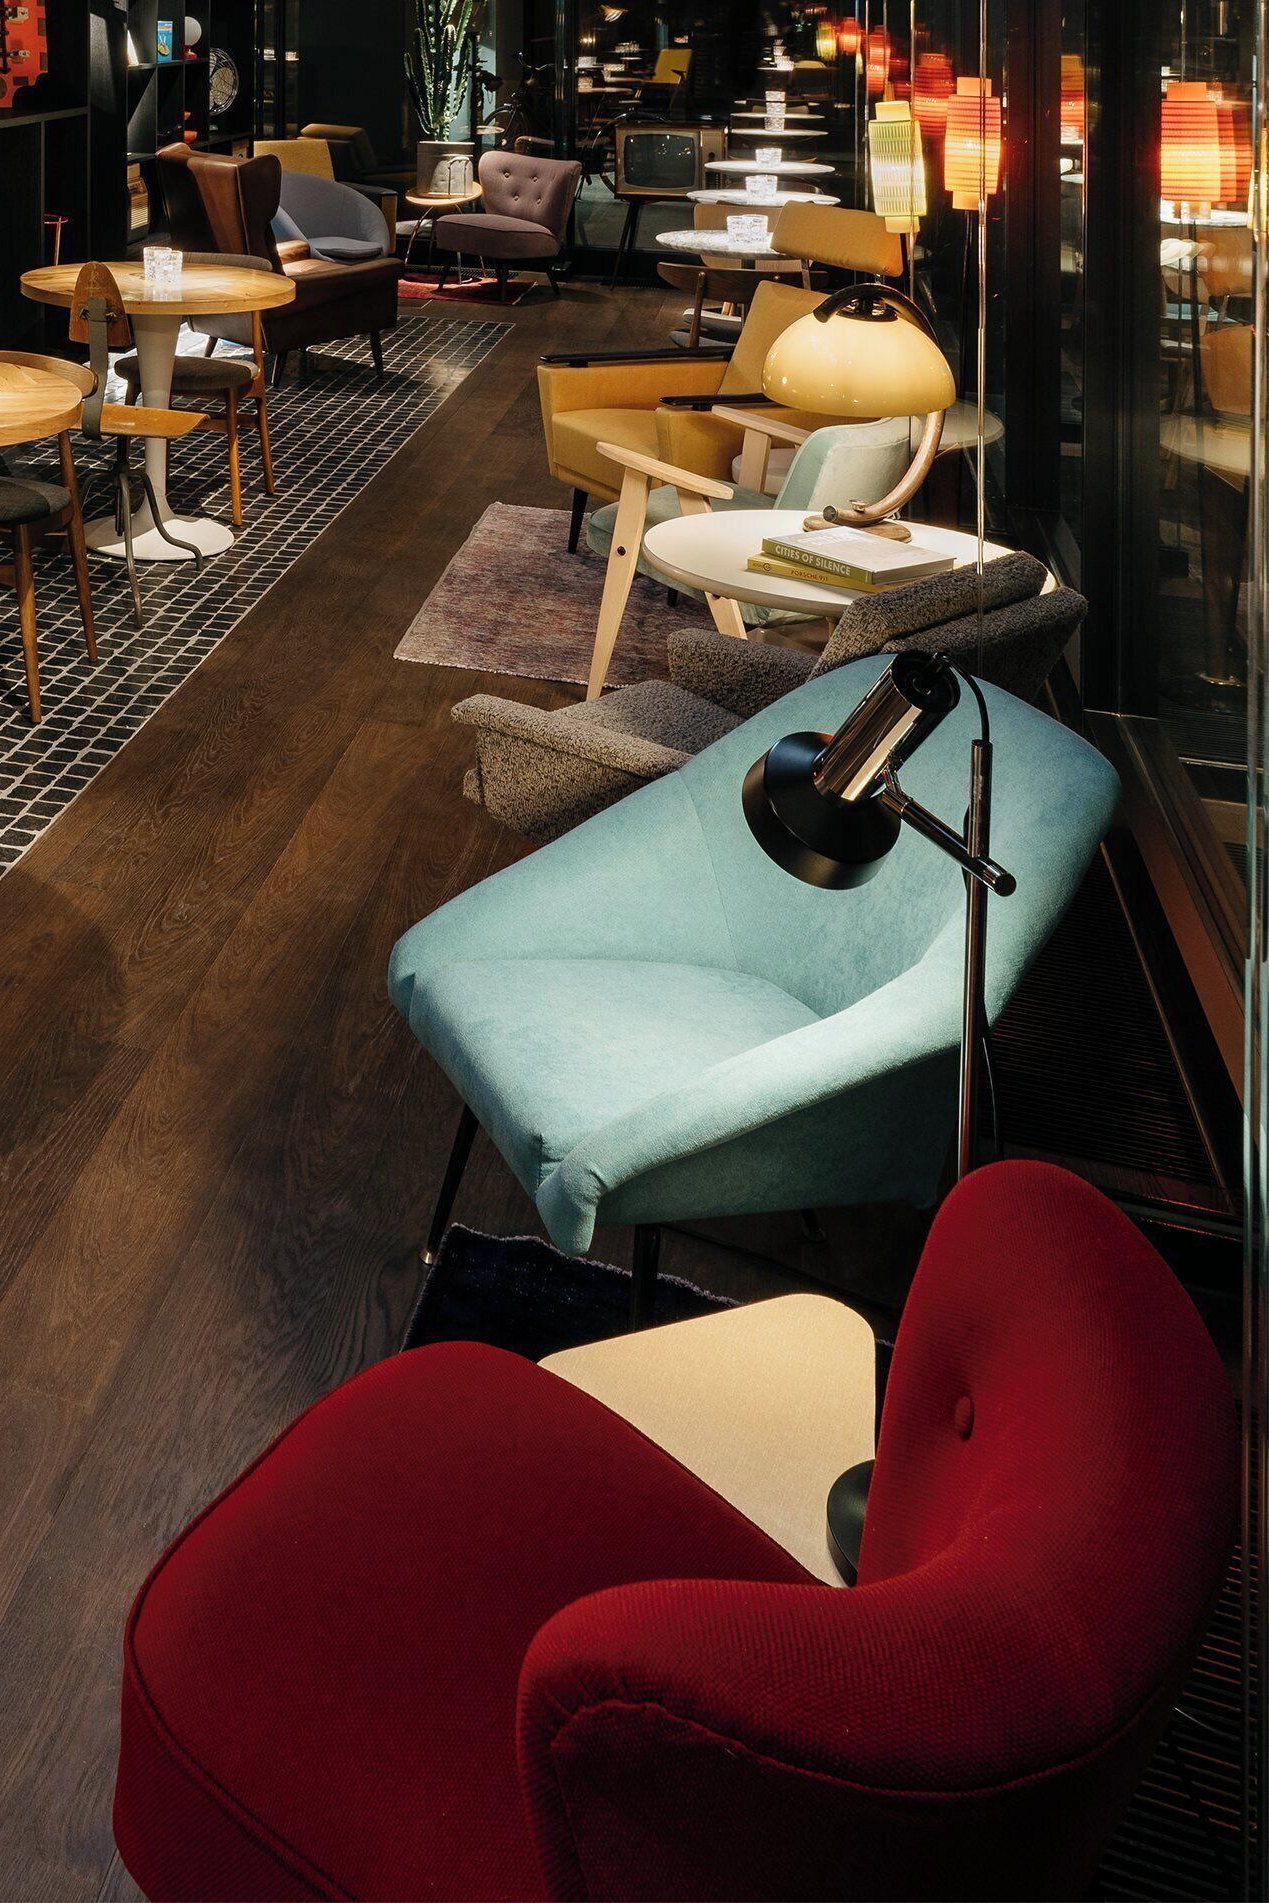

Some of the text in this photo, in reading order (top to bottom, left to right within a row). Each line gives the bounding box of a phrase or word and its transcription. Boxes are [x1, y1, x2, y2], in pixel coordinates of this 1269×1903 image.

[775, 545, 851, 576] CITIES OF SILENCE
